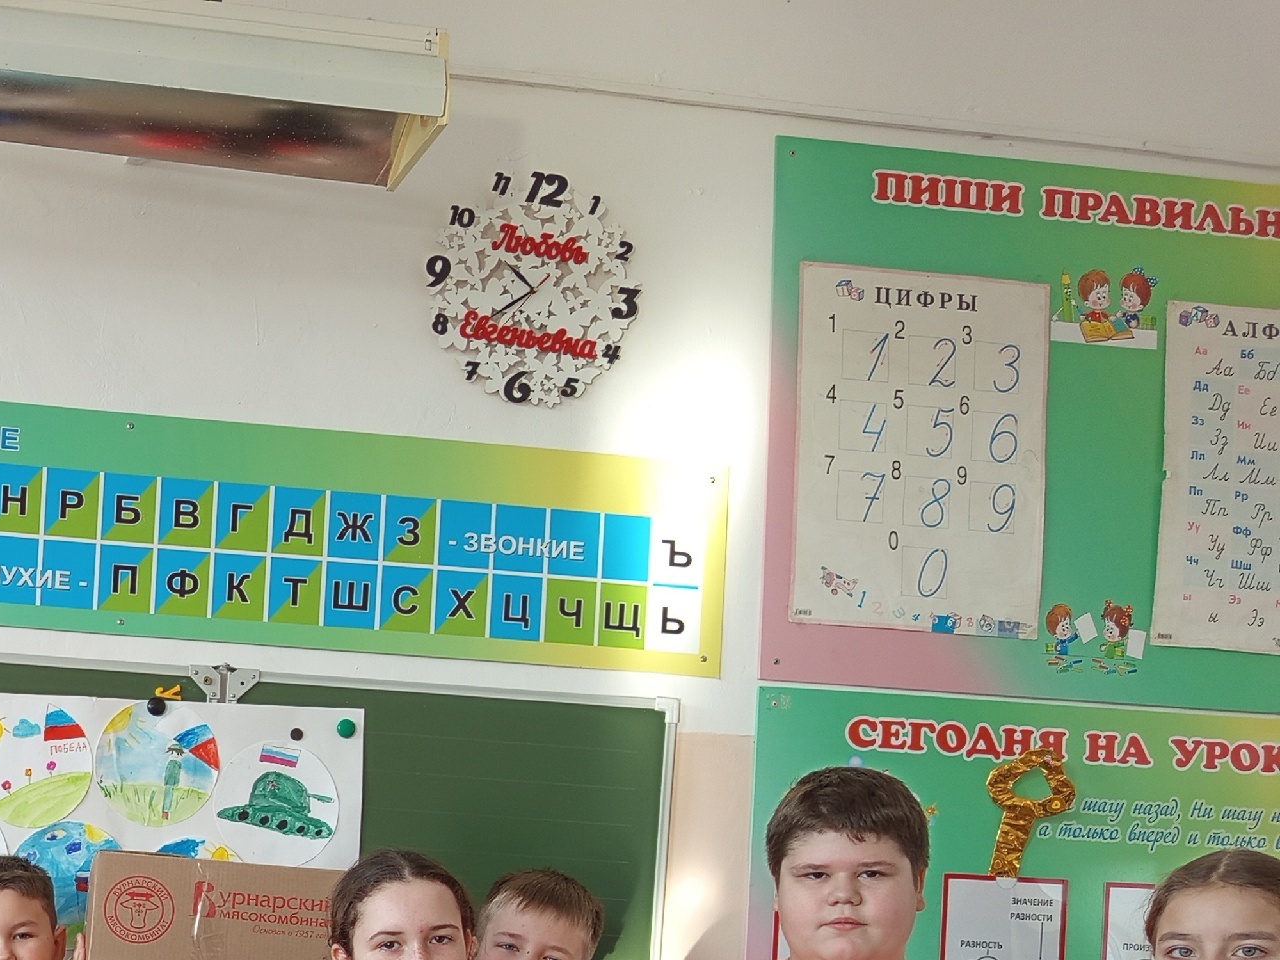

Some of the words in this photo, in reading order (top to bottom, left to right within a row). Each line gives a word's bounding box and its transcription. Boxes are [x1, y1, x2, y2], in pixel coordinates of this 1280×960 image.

[525, 171, 568, 208] 12
[449, 205, 475, 228] 10
[589, 195, 601, 215] 1
[874, 171, 1023, 214] ПИШИ
[1041, 188, 1280, 239] ПРАВИЛЬН
[492, 222, 589, 264] Любовь
[615, 241, 633, 262] 2
[426, 255, 451, 288] 9
[611, 287, 641, 320] 3
[874, 286, 978, 312] ЦИФРЫ
[432, 313, 448, 335] 8
[460, 310, 597, 359] Евгеньевна
[602, 344, 621, 364] 4
[828, 314, 837, 333] 1
[870, 333, 889, 381] 1
[894, 320, 905, 339] 2
[929, 338, 957, 387] 2
[962, 325, 973, 345] 3
[993, 344, 1020, 393] 3
[1194, 346, 1208, 356] Аа
[1240, 349, 1254, 359] Бб
[465, 361, 480, 381] 7
[504, 370, 536, 403] 6
[561, 378, 579, 397] 5
[826, 384, 837, 404] 4
[863, 404, 886, 452] 4
[893, 390, 904, 409] 5
[926, 407, 955, 457] 5
[959, 396, 970, 415] 6
[989, 413, 1018, 463] 6
[825, 455, 835, 474] 7
[861, 472, 886, 522] 7
[892, 461, 901, 480] 8
[921, 479, 951, 527] 8
[957, 466, 967, 485] 9
[987, 484, 1016, 532] 9
[0, 484, 29, 518] Н
[60, 489, 86, 521] Р
[115, 494, 141, 526] Б
[174, 498, 201, 530] В
[229, 502, 255, 533] Г
[282, 507, 313, 543] Д
[335, 511, 374, 543] Ж
[396, 515, 421, 547] З
[463, 531, 586, 562] ЗВОНКИЕ
[662, 539, 694, 568] Ъ
[889, 531, 898, 550] 0
[918, 549, 948, 597] 0
[112, 563, 138, 595] П
[166, 566, 200, 599] Ф
[226, 571, 251, 603] К
[284, 575, 308, 607] Т
[332, 579, 370, 613] Ш
[392, 584, 420, 616] С
[447, 588, 476, 621] Х
[502, 592, 531, 630] Ц
[557, 597, 584, 629] Ч
[603, 601, 642, 638] Щ
[661, 606, 686, 635] Ь
[847, 717, 1067, 760] СЕГОДНЯ
[1085, 732, 1151, 766] НА
[1082, 800, 1124, 822] шагу
[1133, 799, 1181, 822] назад,
[1191, 801, 1214, 819] Ни
[1221, 808, 1263, 830] шагу
[1038, 826, 1050, 837] а
[1058, 824, 1120, 841] только
[1128, 823, 1180, 851] вперед
[1187, 834, 1199, 845] и
[1207, 831, 1267, 849] только
[112, 878, 169, 902] ВУРНАРСКИЙ
[1011, 897, 1054, 907] ЗНАЧЕНИЕ
[107, 914, 170, 942] МЯСОКОМБИНАТ
[1010, 912, 1053, 922] РАЗНОСТИ
[295, 930, 314, 938] 1957
[960, 939, 1003, 950] РАЗНОСТЬ
